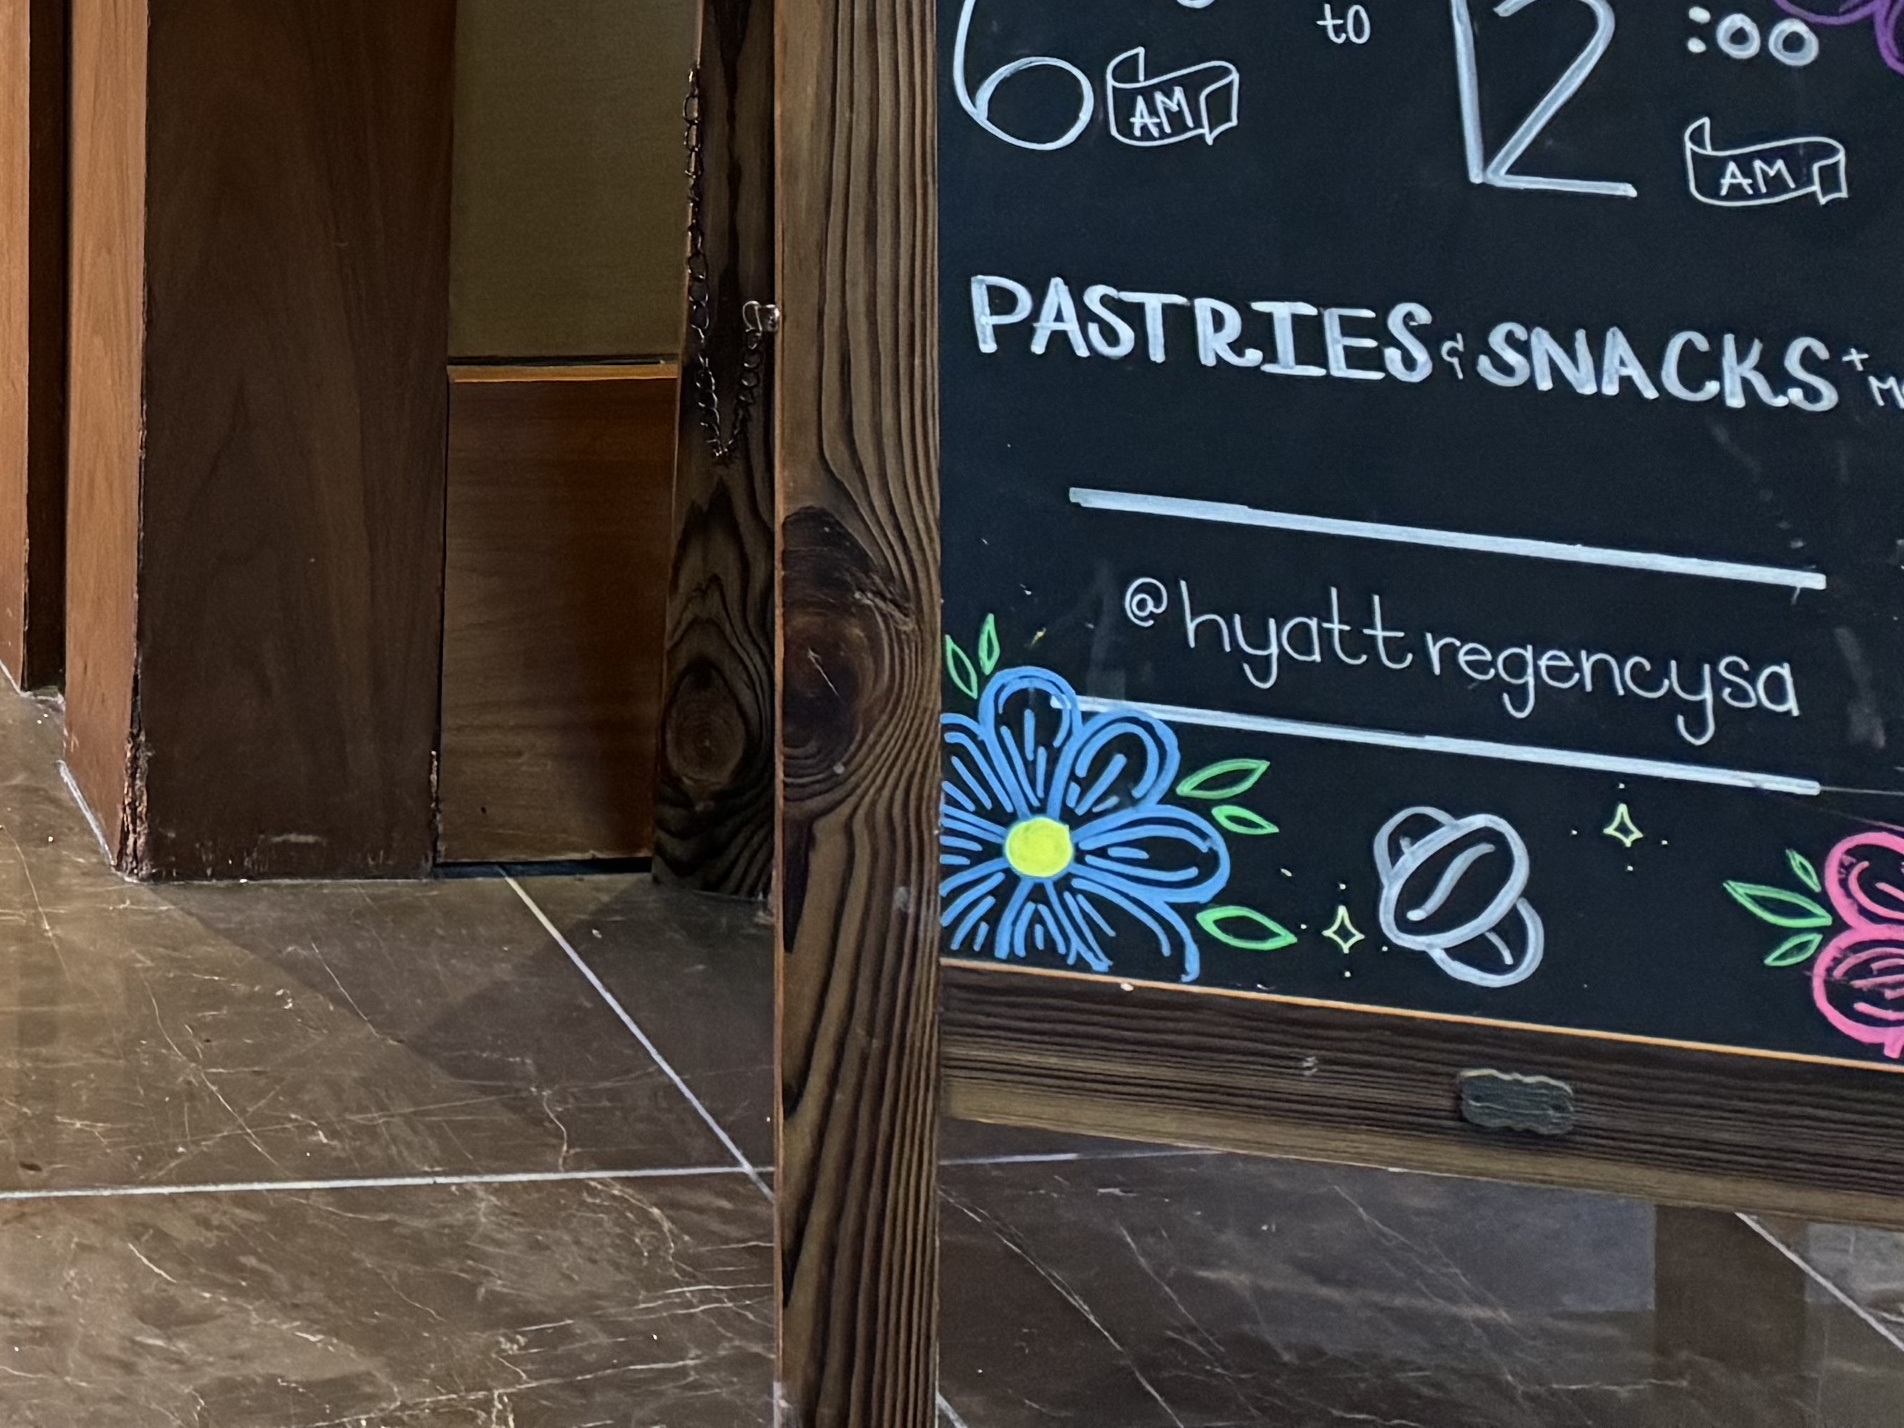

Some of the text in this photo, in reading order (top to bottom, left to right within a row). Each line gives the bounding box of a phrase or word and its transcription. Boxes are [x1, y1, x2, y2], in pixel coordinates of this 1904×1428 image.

[1129, 86, 1194, 138] AM
[1316, 3, 1371, 44] to
[1720, 158, 1796, 196] AM
[970, 274, 1433, 383] PASTRIES
[1476, 322, 1839, 412] SNACKS
[1124, 577, 1801, 746] @hyattregencysa
